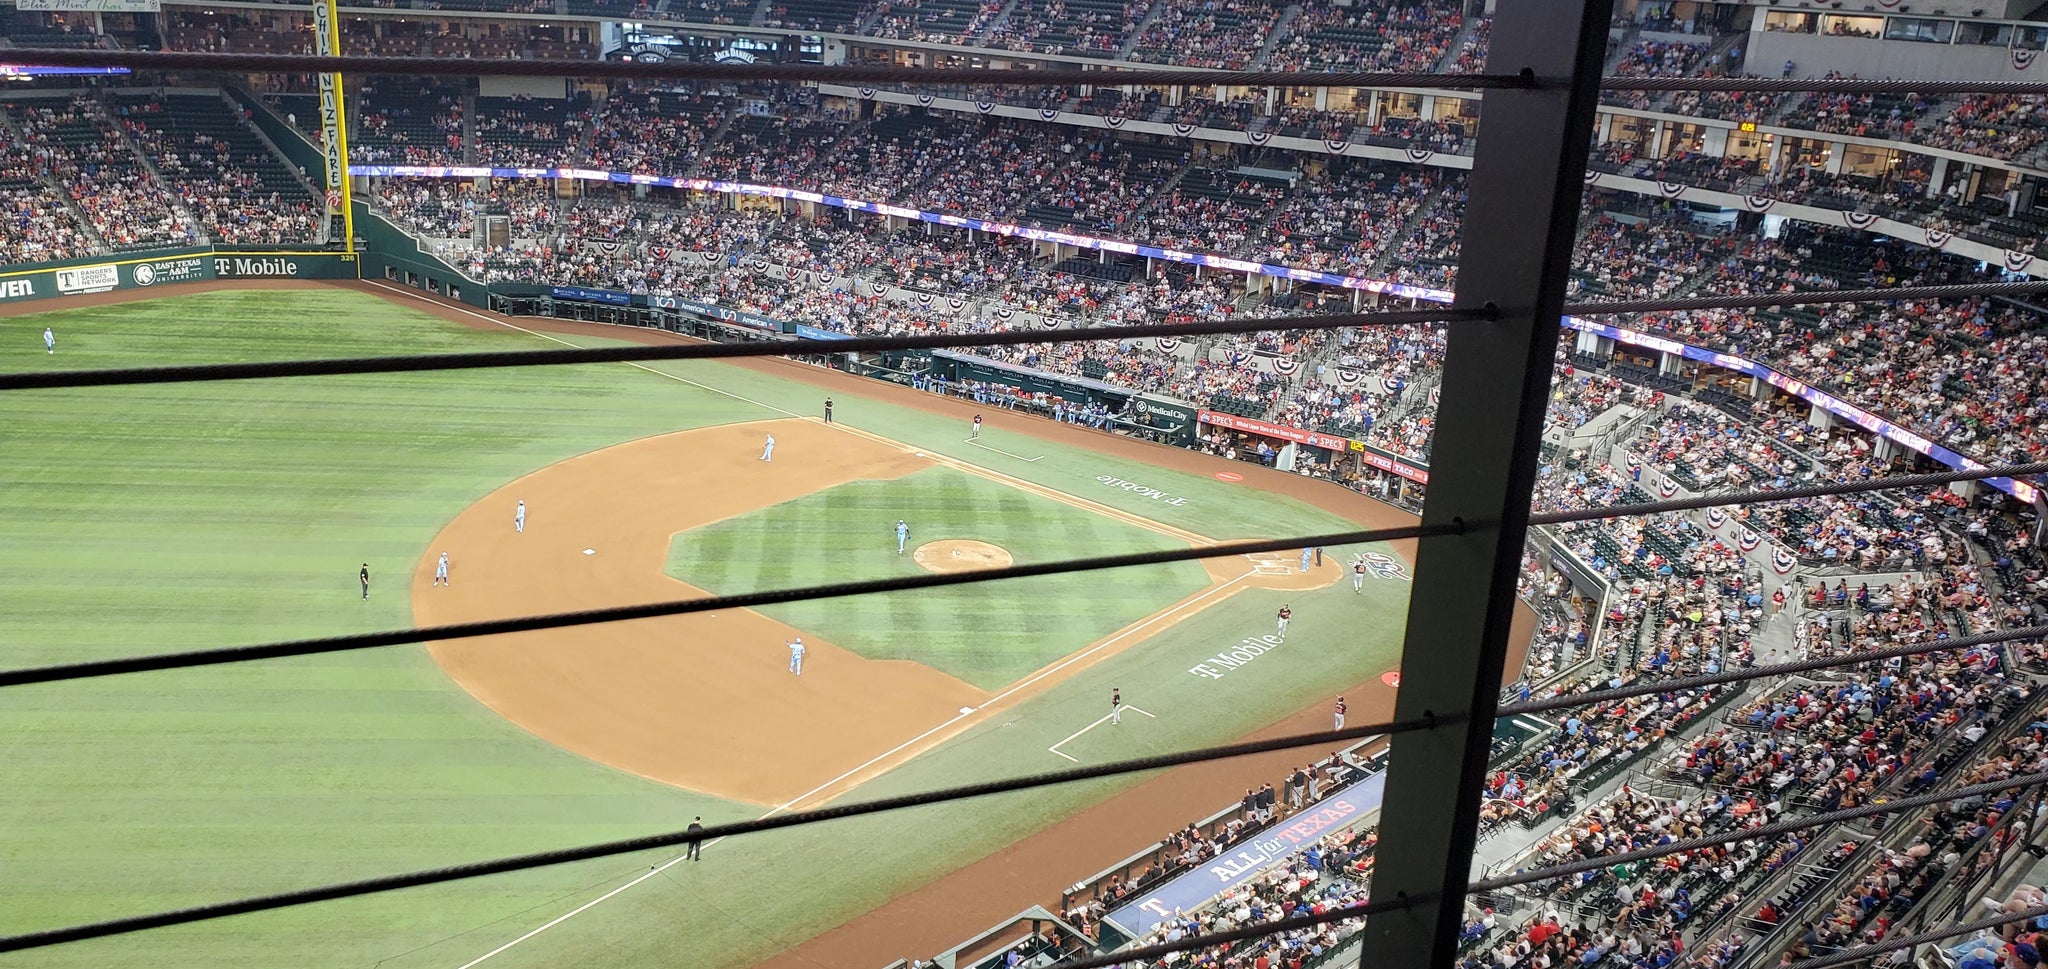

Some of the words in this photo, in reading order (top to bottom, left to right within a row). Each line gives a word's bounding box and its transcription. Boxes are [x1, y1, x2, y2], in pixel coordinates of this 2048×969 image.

[316, 6, 332, 87] CHIKN
[327, 130, 339, 183] FARE
[155, 261, 176, 270] EAST
[176, 258, 202, 268] TEXAS
[169, 266, 189, 276] A&M
[235, 258, 297, 275] Mobile
[80, 268, 113, 276] RANGERS
[81, 273, 107, 281] SPORTS
[156, 272, 202, 282] UNIVERSITY
[81, 277, 117, 286] NETWORK
[682, 303, 705, 314] American
[742, 316, 767, 328] American
[1147, 404, 1173, 419] Medical
[1173, 409, 1188, 421] City
[1212, 415, 1233, 426] SPEC'S
[1320, 437, 1344, 449] SPEC'S
[1372, 456, 1392, 469] FREE
[1394, 463, 1414, 476] TACO
[1096, 474, 1167, 500] Mobile
[1206, 634, 1284, 671] Mobile
[1210, 851, 1267, 883] ALL
[1254, 838, 1285, 862] for
[1277, 800, 1356, 843] TEXAS
